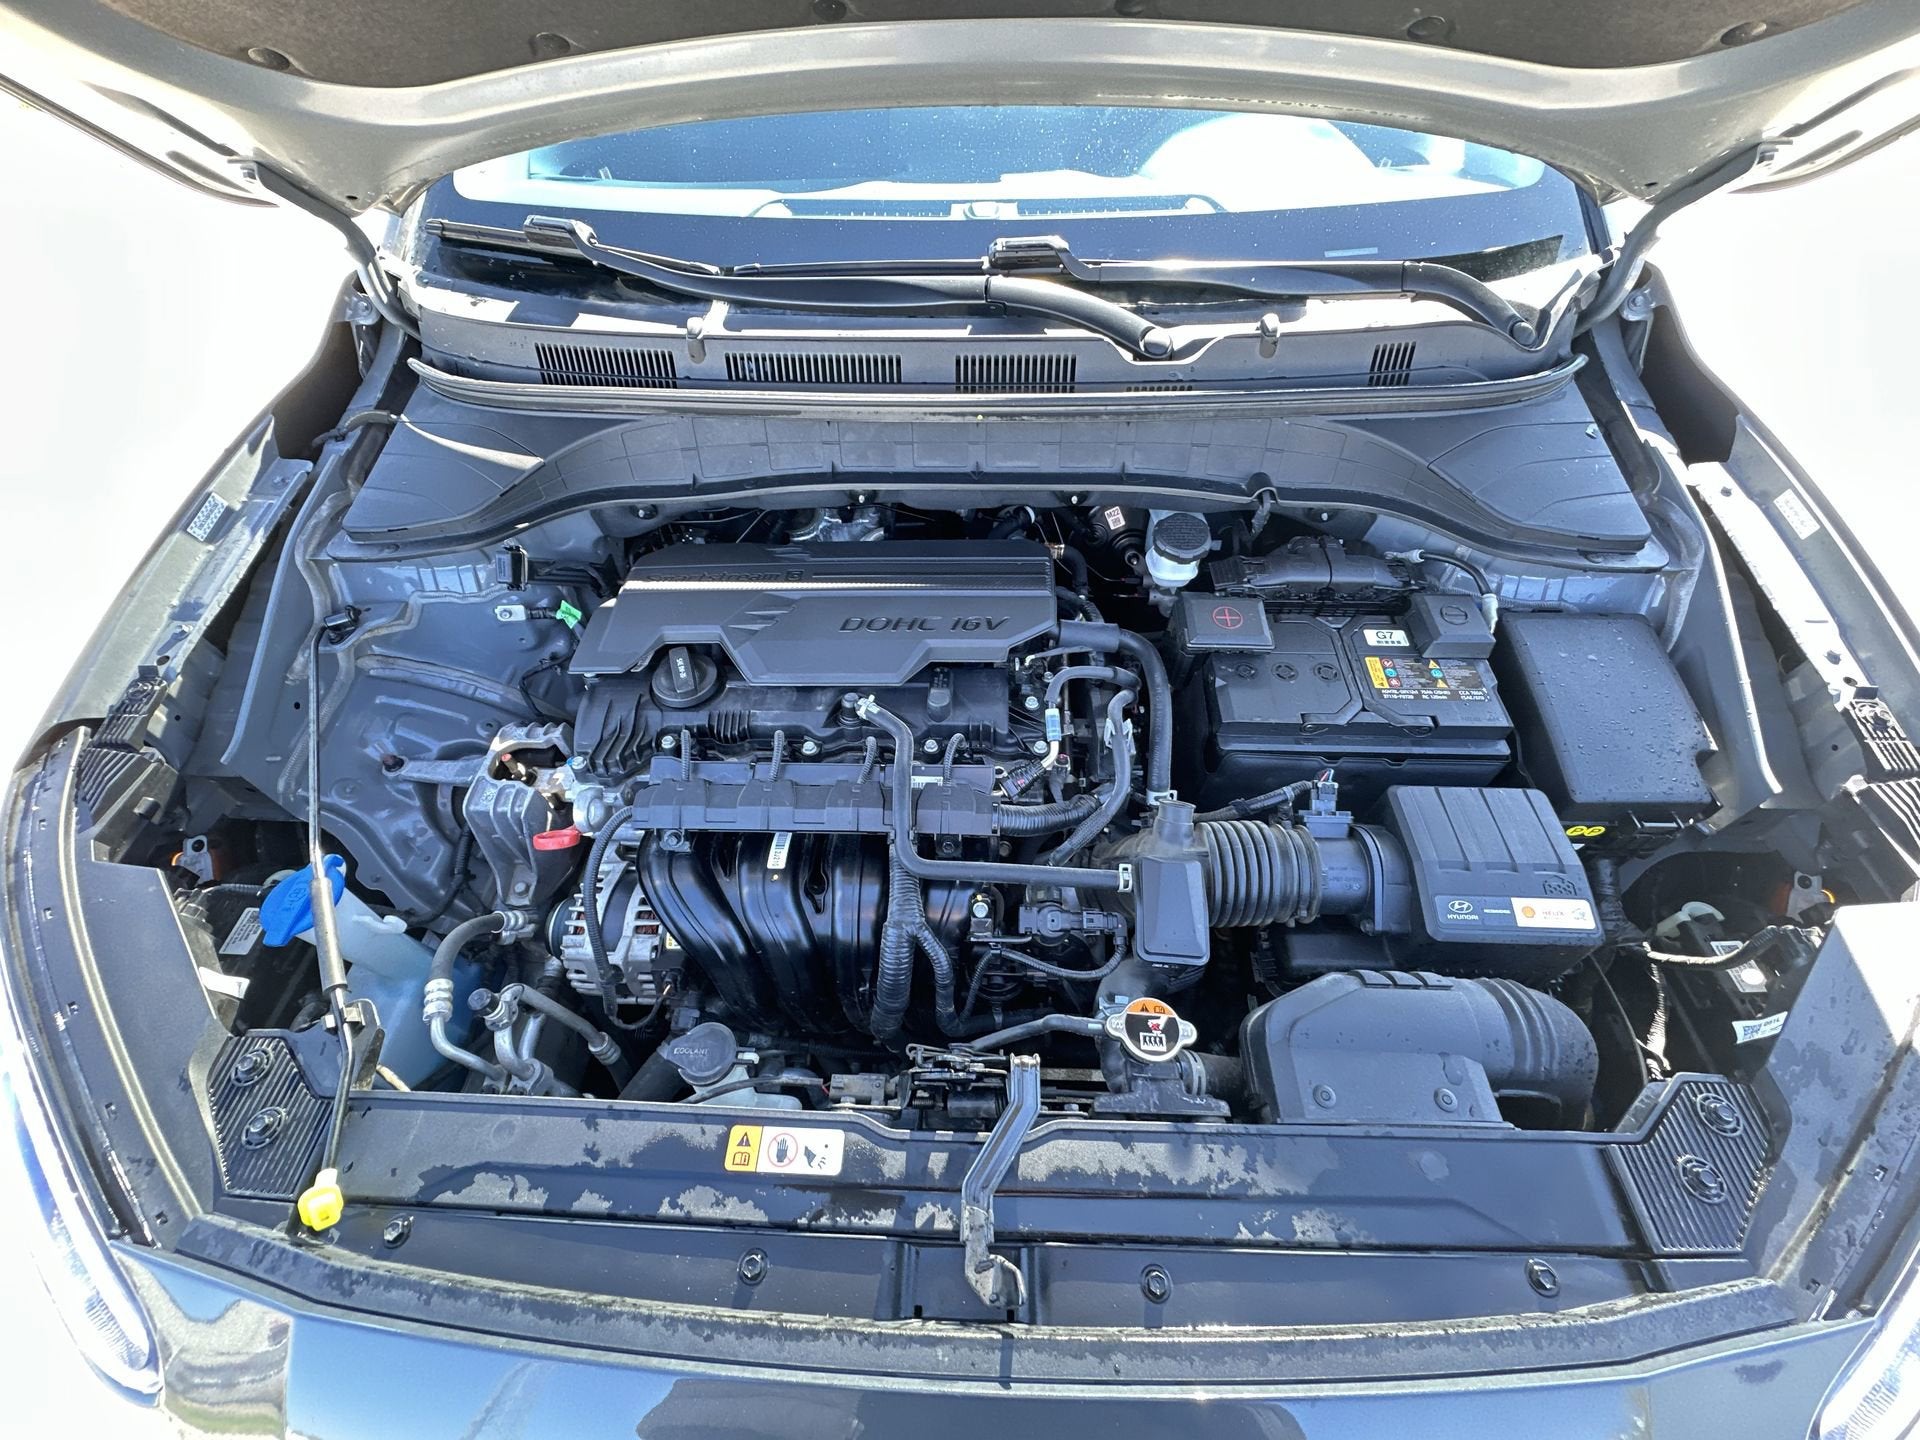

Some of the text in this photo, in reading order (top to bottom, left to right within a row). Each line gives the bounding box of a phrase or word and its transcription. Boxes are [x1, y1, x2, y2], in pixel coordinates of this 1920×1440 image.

[839, 616, 1010, 633] DOHC 16V
[1376, 631, 1394, 639] G7
[673, 1047, 708, 1055] COOLANT
